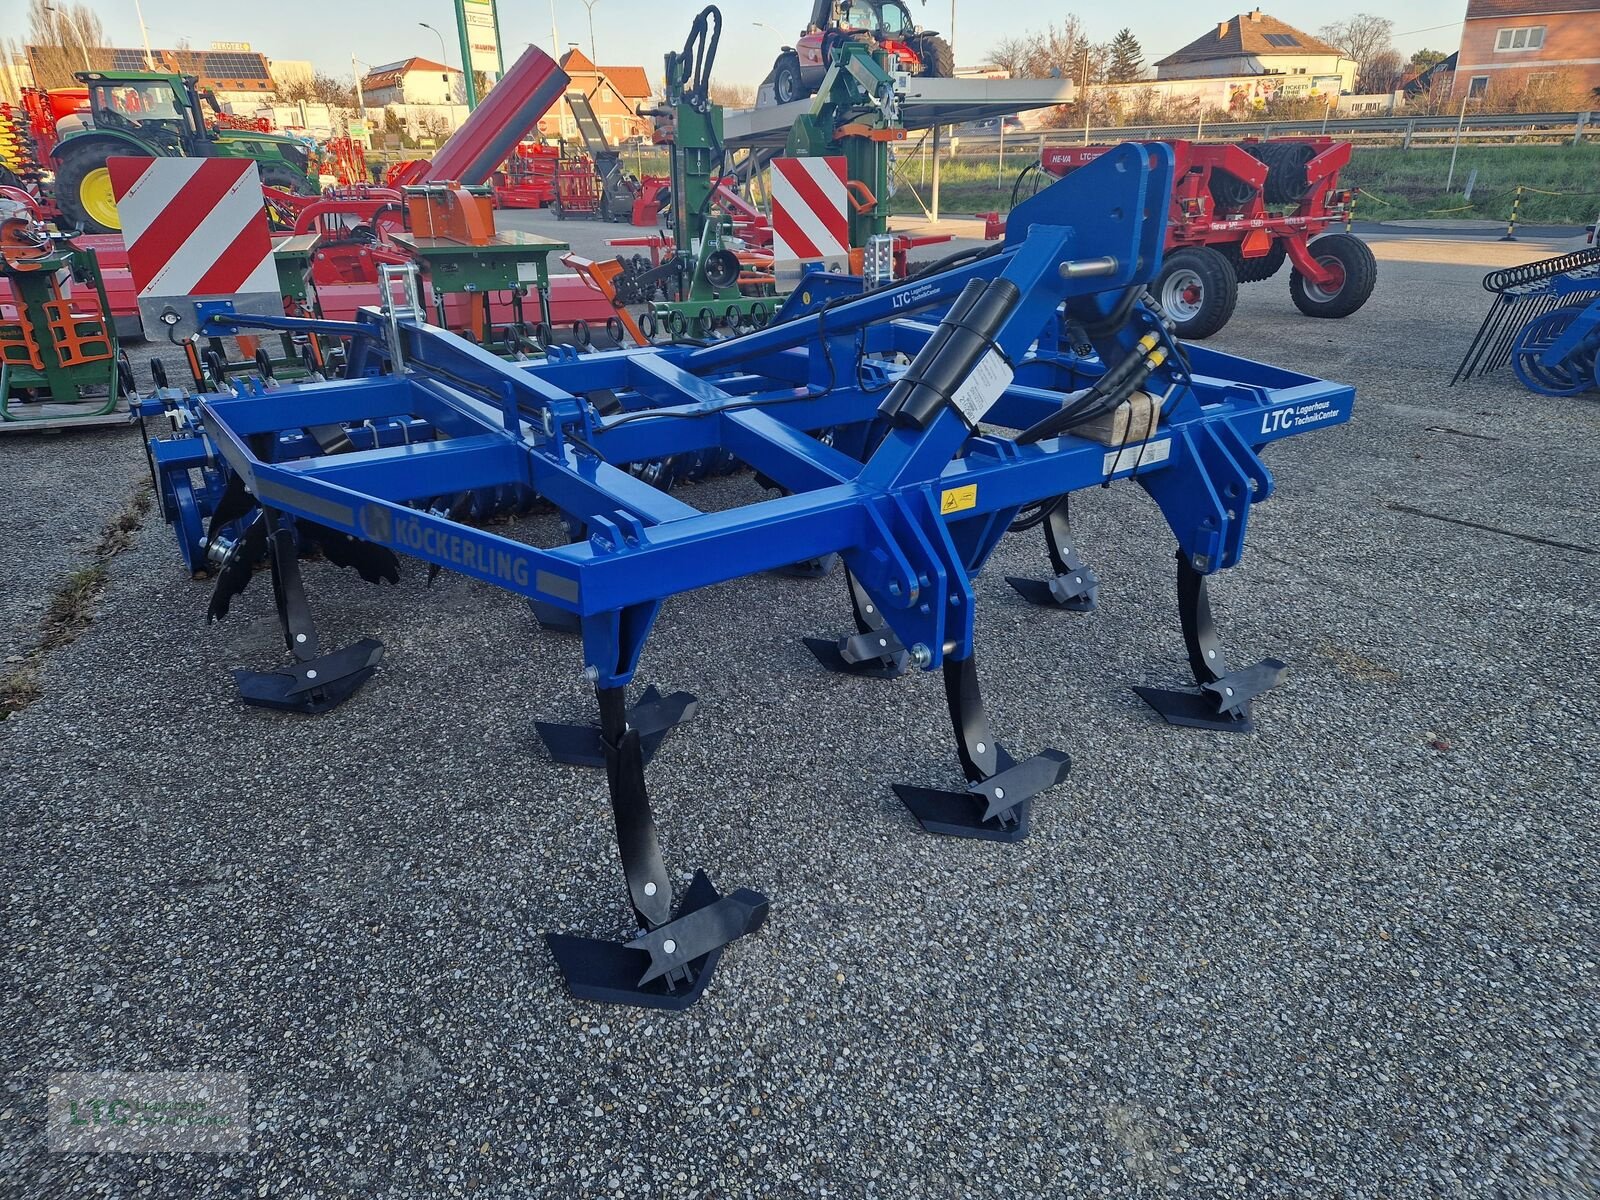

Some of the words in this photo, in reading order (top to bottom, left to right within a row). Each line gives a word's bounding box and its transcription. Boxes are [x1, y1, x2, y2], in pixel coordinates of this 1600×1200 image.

[1052, 155, 1071, 163] HE-VA
[1080, 152, 1092, 161] LTC
[910, 283, 933, 296] Lagerhaus
[892, 291, 911, 308] LTC
[1296, 400, 1330, 415] Lagerhaus
[1261, 407, 1295, 434] LTC
[1294, 409, 1340, 426] TechnikCenter
[394, 516, 529, 587] KÖCKERLING
